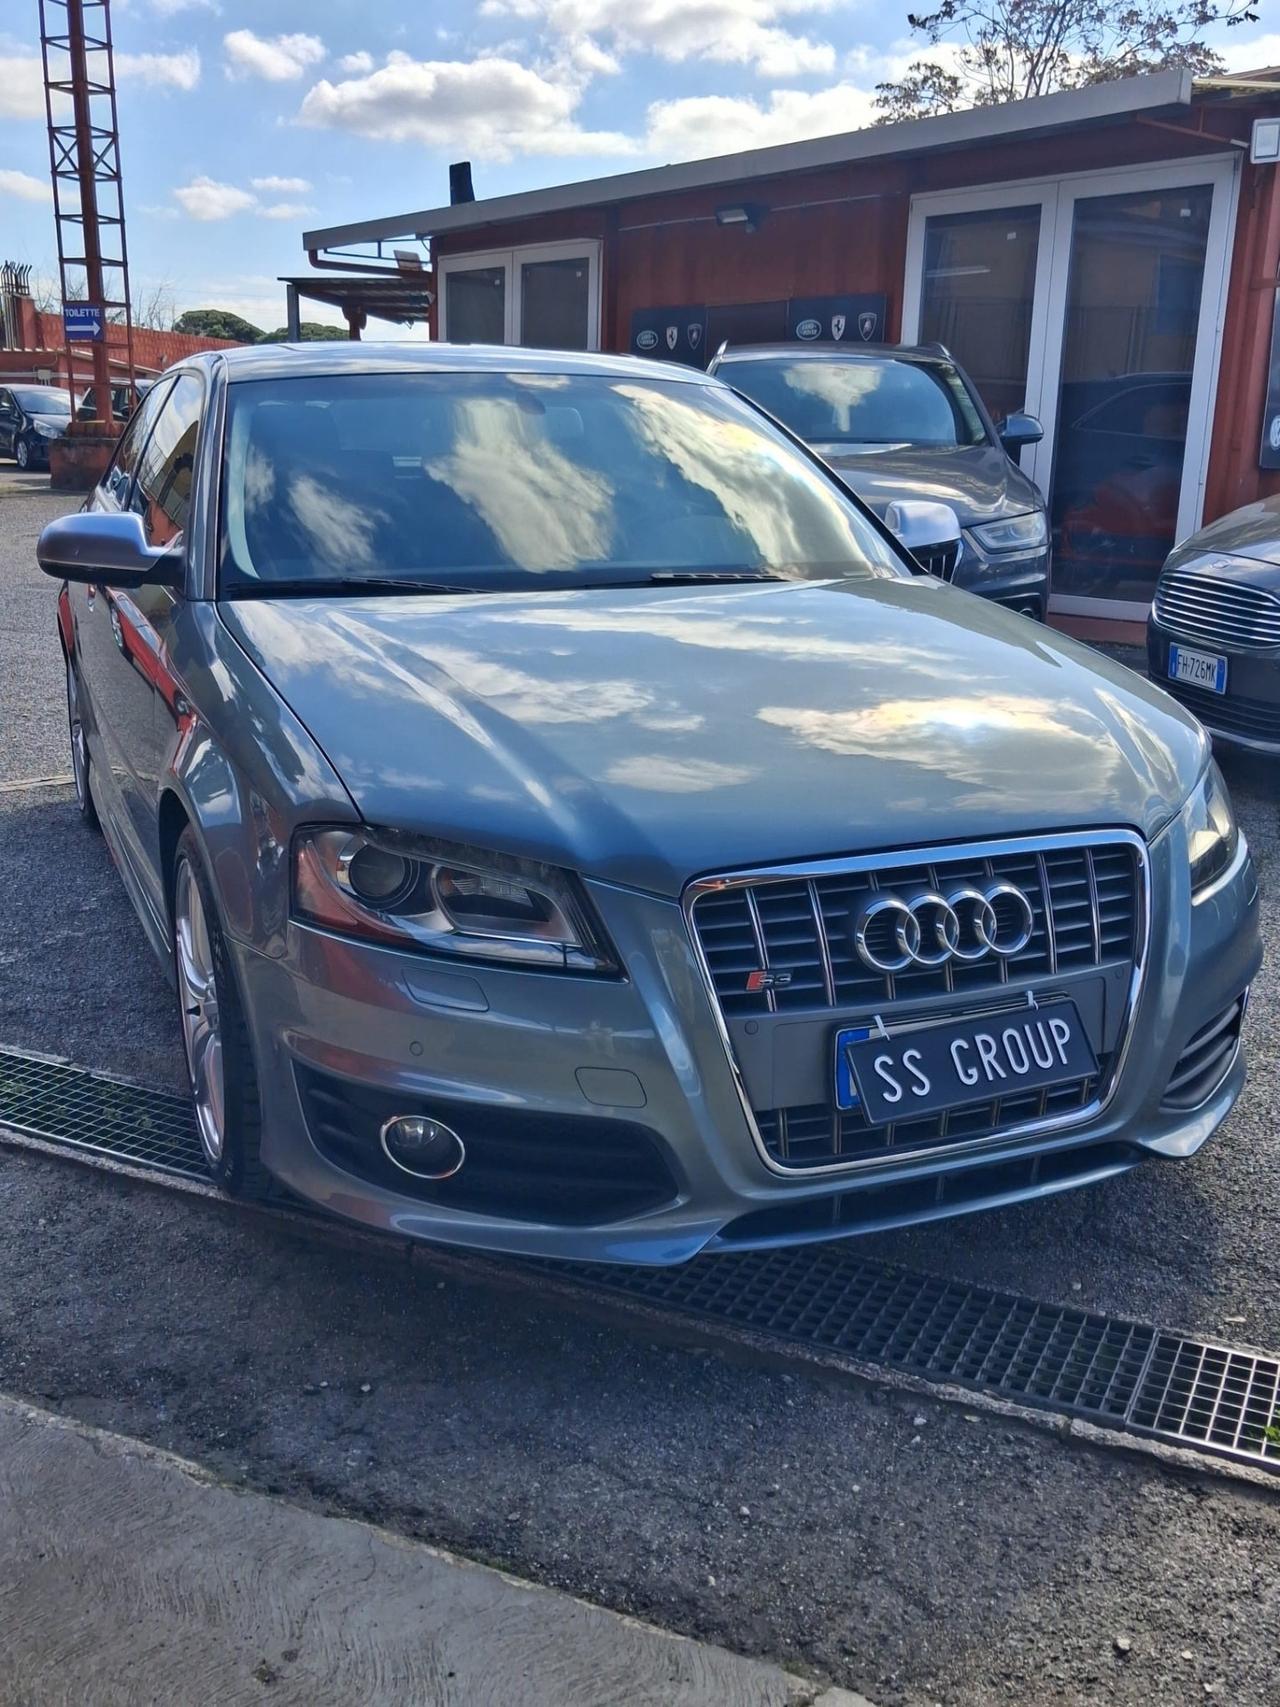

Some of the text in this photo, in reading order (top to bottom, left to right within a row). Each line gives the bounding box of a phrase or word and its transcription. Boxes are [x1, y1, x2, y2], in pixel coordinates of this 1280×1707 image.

[64, 308, 100, 318] TOILETTE
[873, 1018, 1071, 1103] SS GROUP
